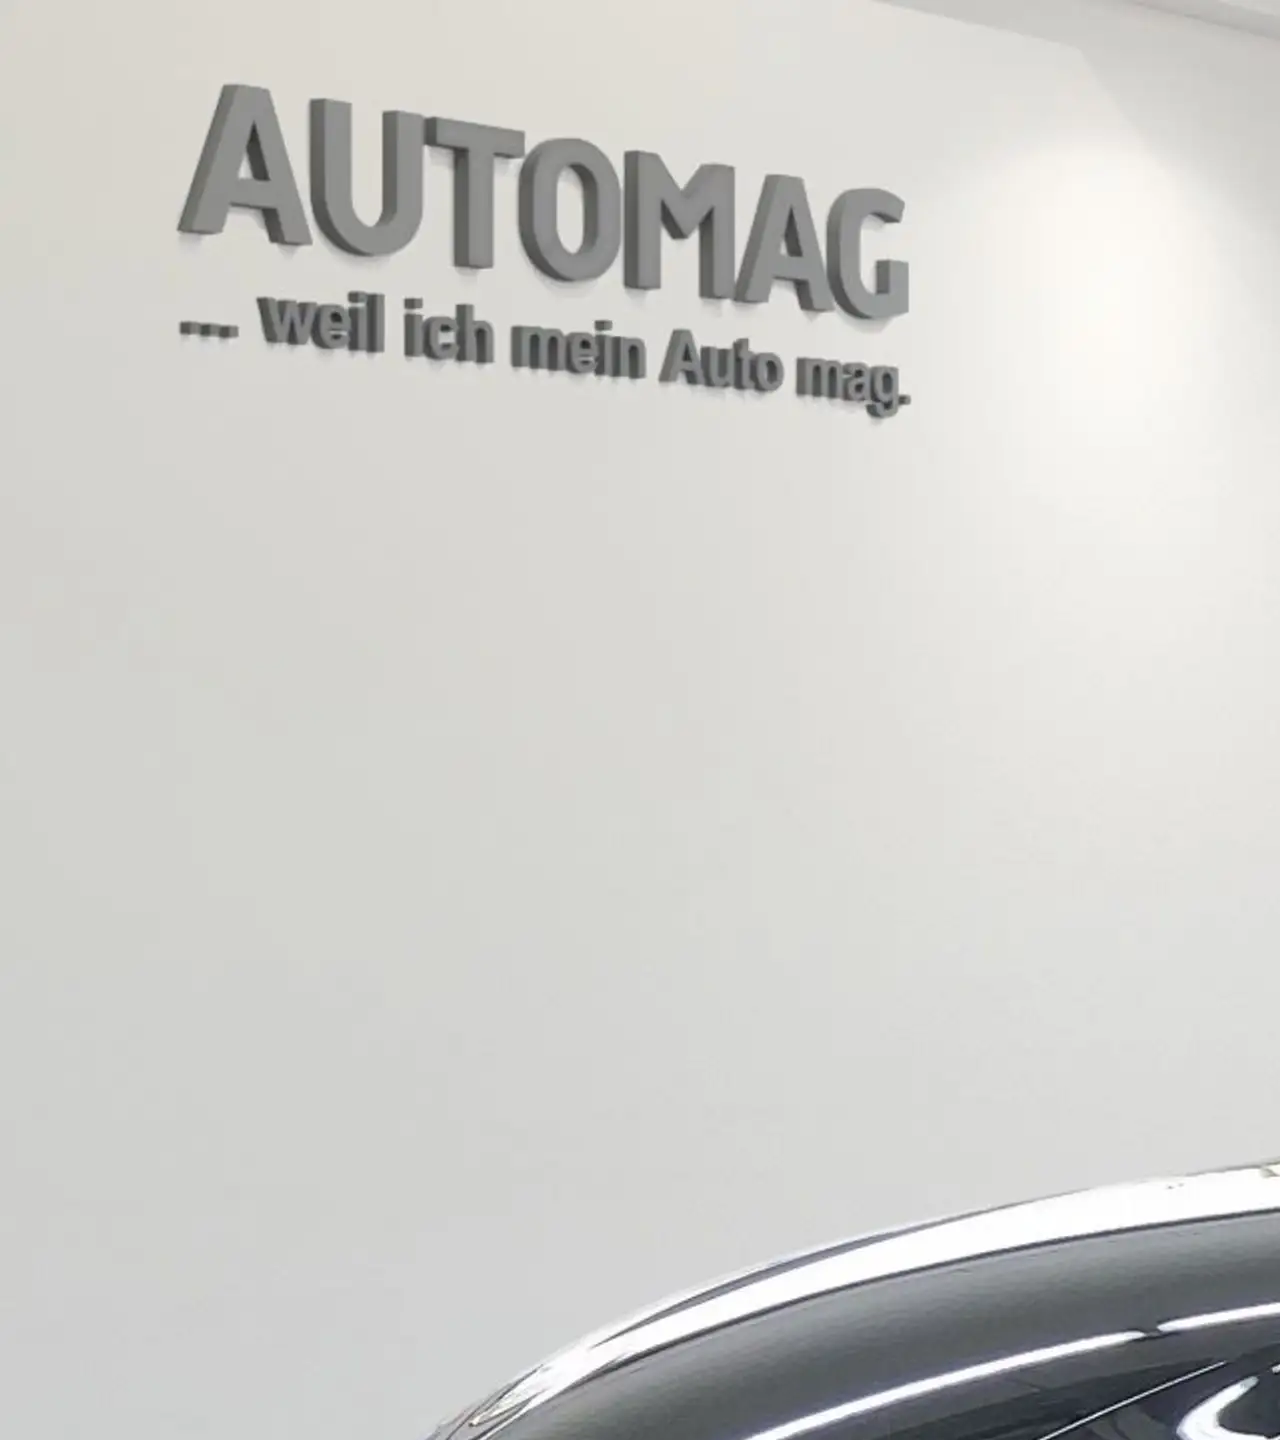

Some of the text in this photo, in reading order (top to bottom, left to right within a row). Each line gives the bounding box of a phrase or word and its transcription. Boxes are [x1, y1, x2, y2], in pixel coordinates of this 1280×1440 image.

[178, 84, 909, 319] AUTOMAG
[255, 290, 386, 353] weil
[403, 297, 495, 363] ich
[510, 319, 647, 380] mein
[658, 328, 785, 392] Auto
[795, 356, 912, 419] mag.
